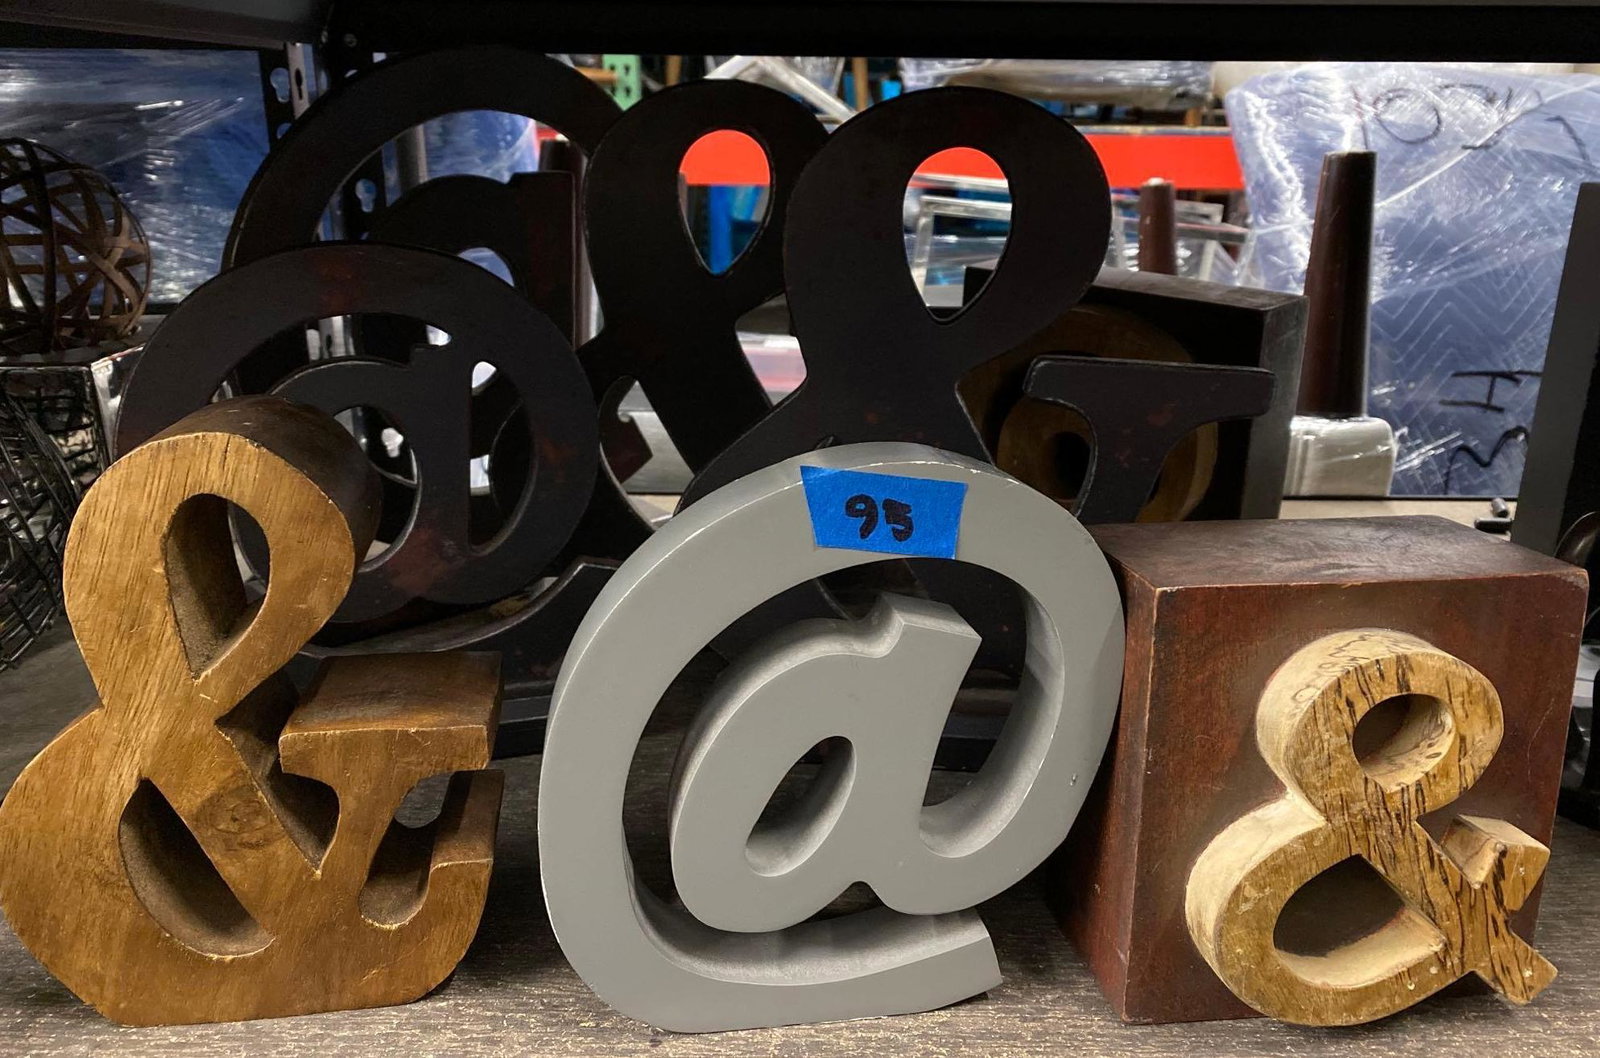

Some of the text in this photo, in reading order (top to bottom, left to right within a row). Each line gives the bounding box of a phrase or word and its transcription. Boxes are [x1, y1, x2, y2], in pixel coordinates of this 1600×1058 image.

[0, 394, 504, 1028] &
[537, 441, 1127, 1034] @
[845, 493, 914, 542] 95
[1185, 628, 1559, 1028] &
